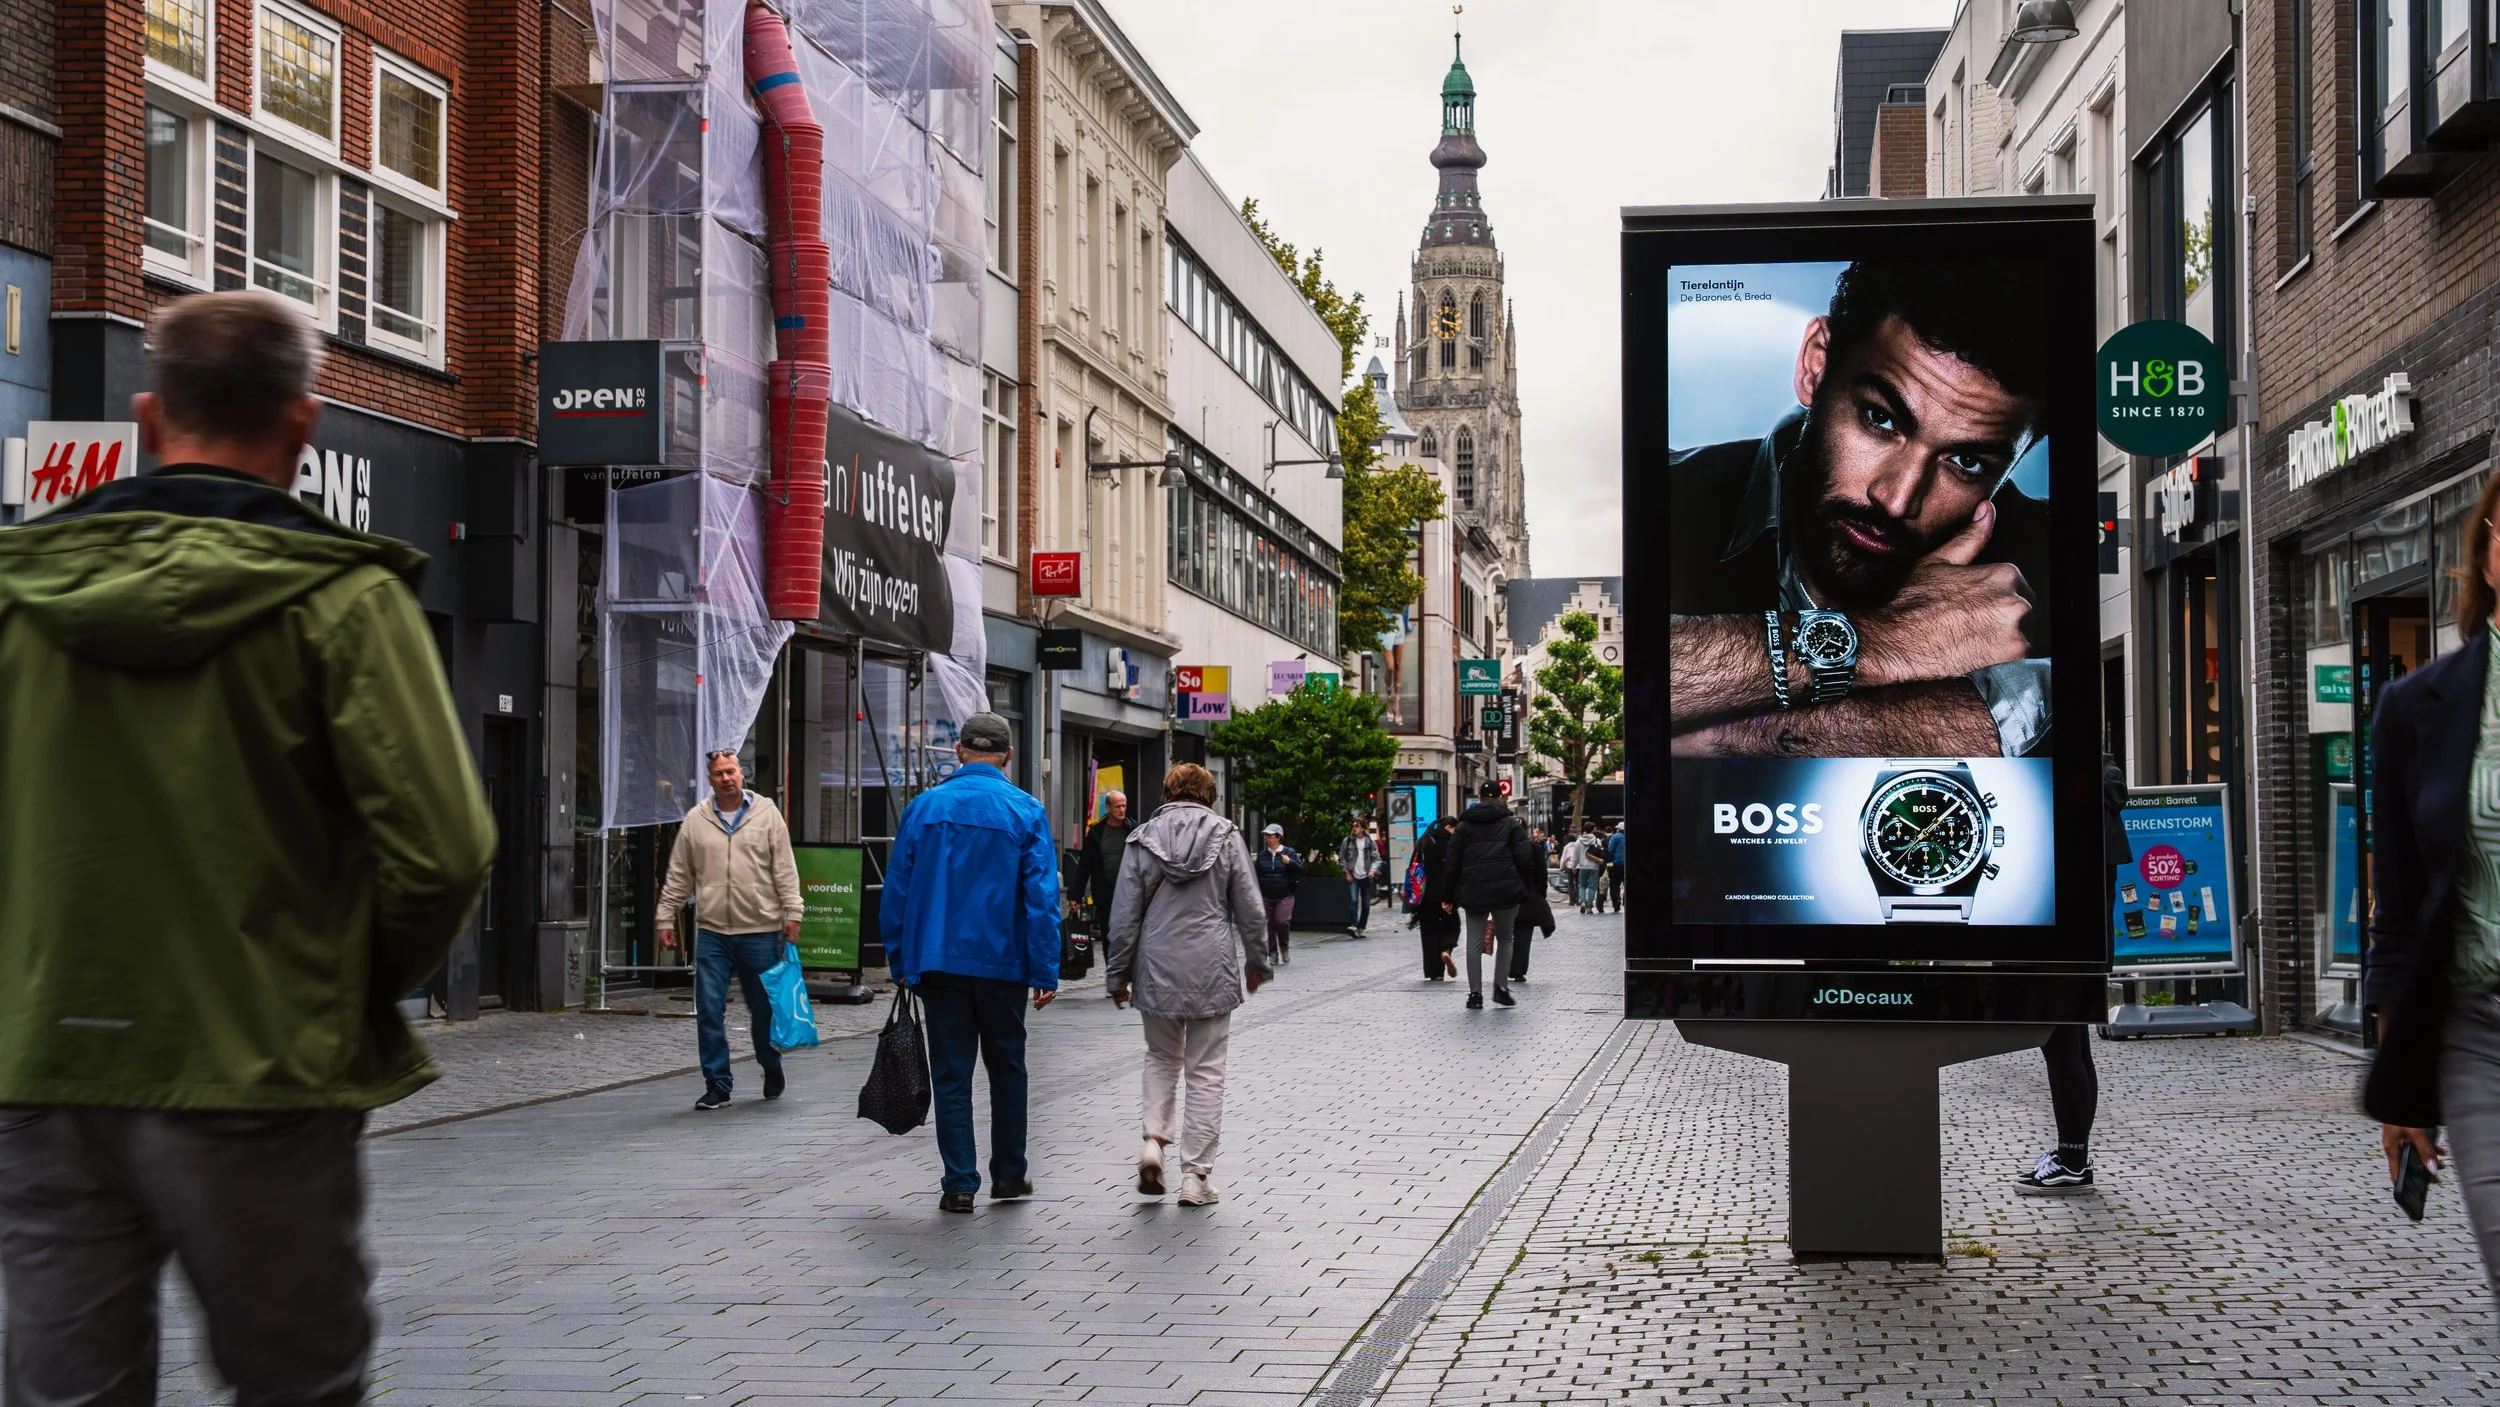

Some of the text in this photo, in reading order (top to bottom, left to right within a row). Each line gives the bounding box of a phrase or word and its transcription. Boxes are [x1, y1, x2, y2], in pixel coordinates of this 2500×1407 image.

[1680, 279, 1744, 291] Tierelantijn
[1680, 291, 1772, 302] De Barones 6, Breda
[2110, 359, 2205, 397] H&B
[635, 387, 645, 408] 32
[2112, 405, 2205, 418] SINCE 1870
[2288, 405, 2338, 492] Holland
[2345, 373, 2412, 460] Barrett
[31, 440, 122, 504] H&M
[583, 469, 661, 480] van uffelen
[356, 457, 371, 534] 32
[823, 458, 944, 548] an uffelen
[833, 547, 919, 622] Wij zijn open
[1771, 628, 1780, 647] BOSS
[1178, 671, 1201, 688] So
[1398, 753, 1425, 765] TES
[2126, 795, 2198, 807] Holland Barrett
[1912, 805, 1937, 813] BOSS
[1713, 802, 1824, 834] BOSS
[2125, 816, 2213, 831] ERKENSTORM
[2148, 853, 2178, 863] 2e product
[2148, 860, 2181, 875] 50%
[807, 883, 853, 894] voordeel
[804, 905, 843, 914] rtingen op
[803, 915, 853, 925] ecteerde items
[812, 946, 842, 955] uffelen
[1812, 988, 1914, 1005] JCDecaux
